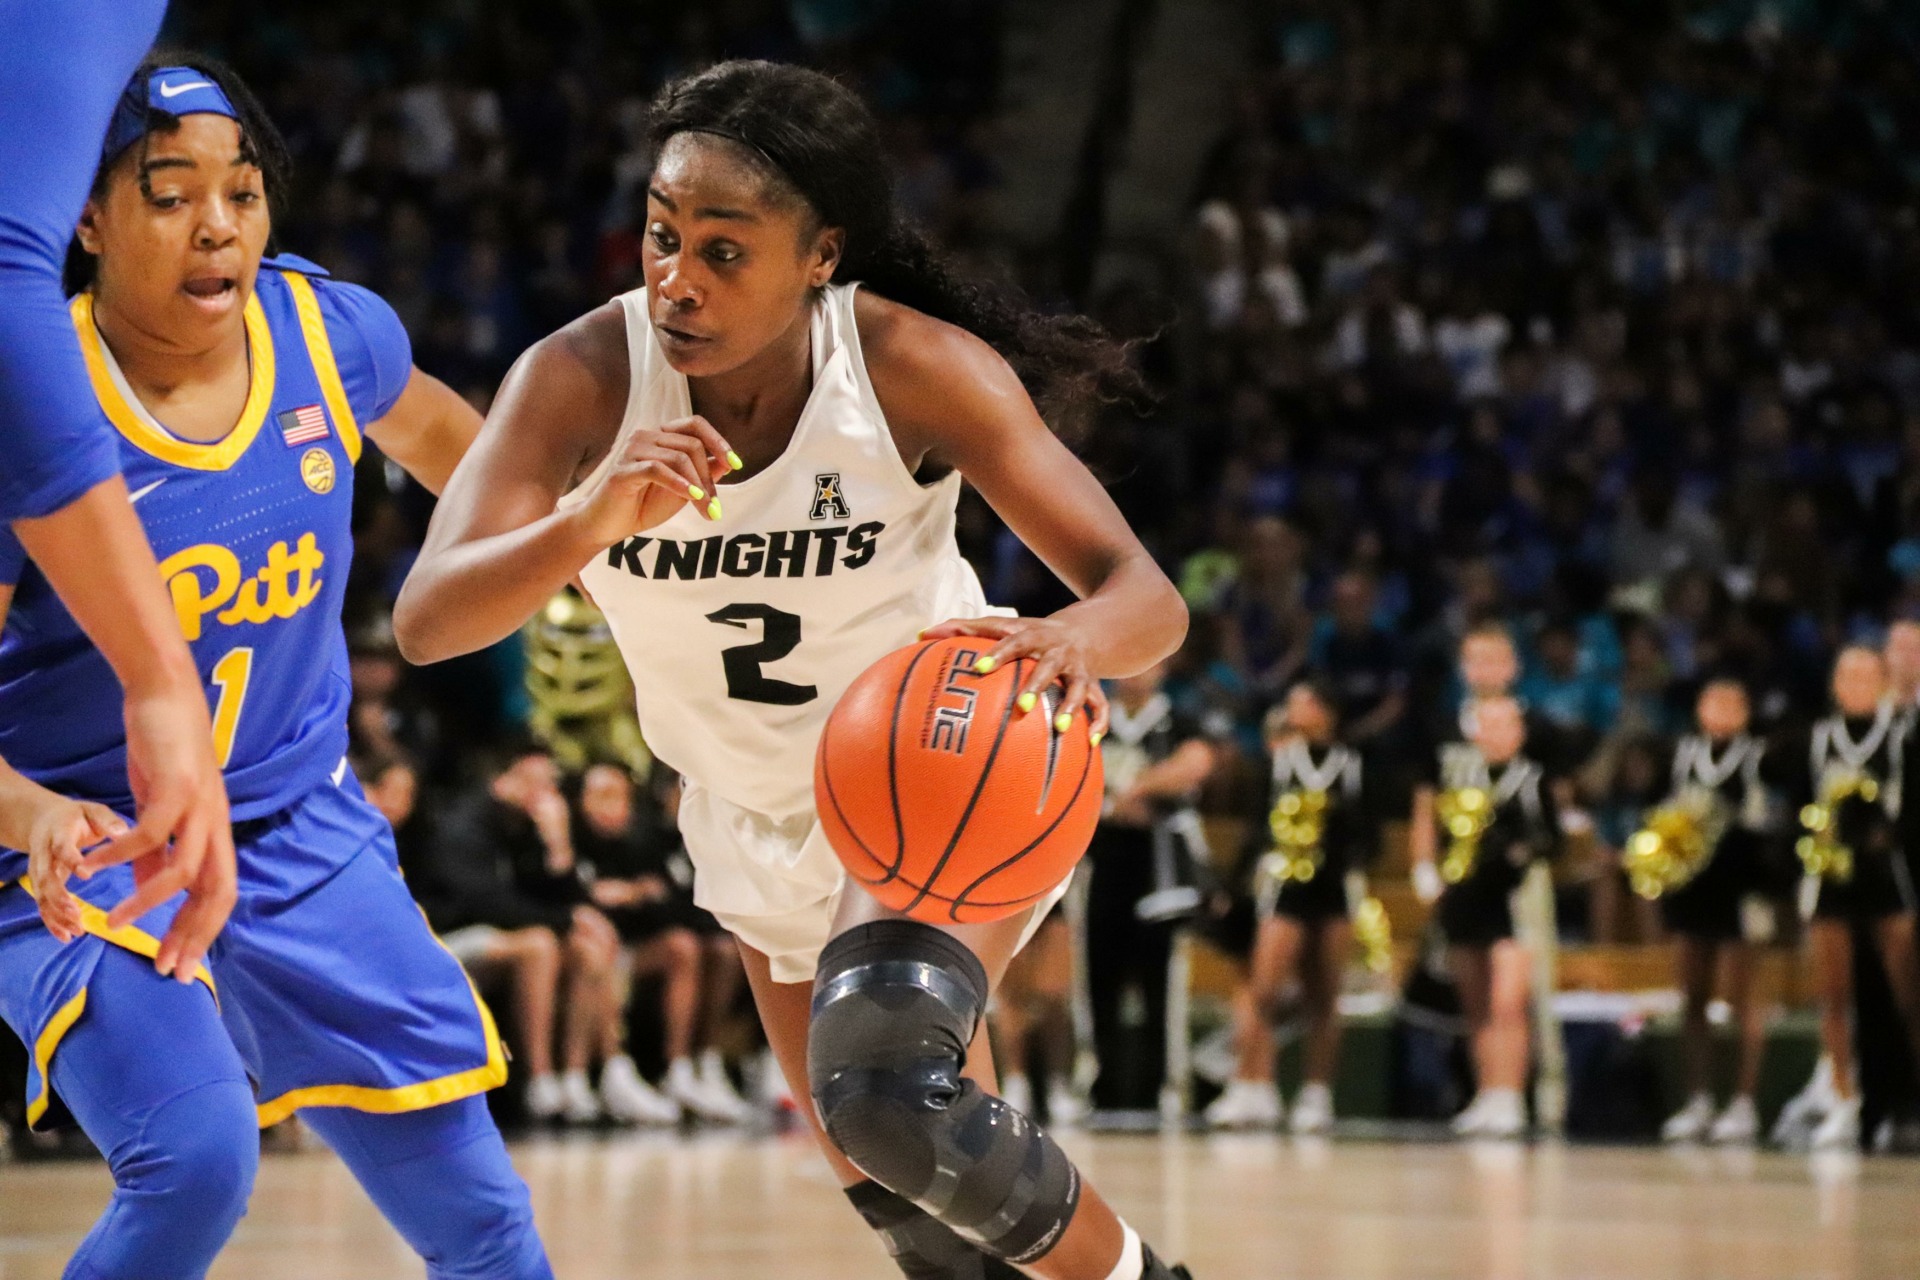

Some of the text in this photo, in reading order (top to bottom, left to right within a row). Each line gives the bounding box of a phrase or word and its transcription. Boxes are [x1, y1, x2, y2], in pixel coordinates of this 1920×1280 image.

[309, 461, 331, 476] ACC
[160, 531, 324, 641] Pitt
[607, 520, 886, 581] KNIGHTS
[704, 602, 818, 706] 2
[930, 648, 984, 755] ELITE
[211, 646, 253, 770] 1
